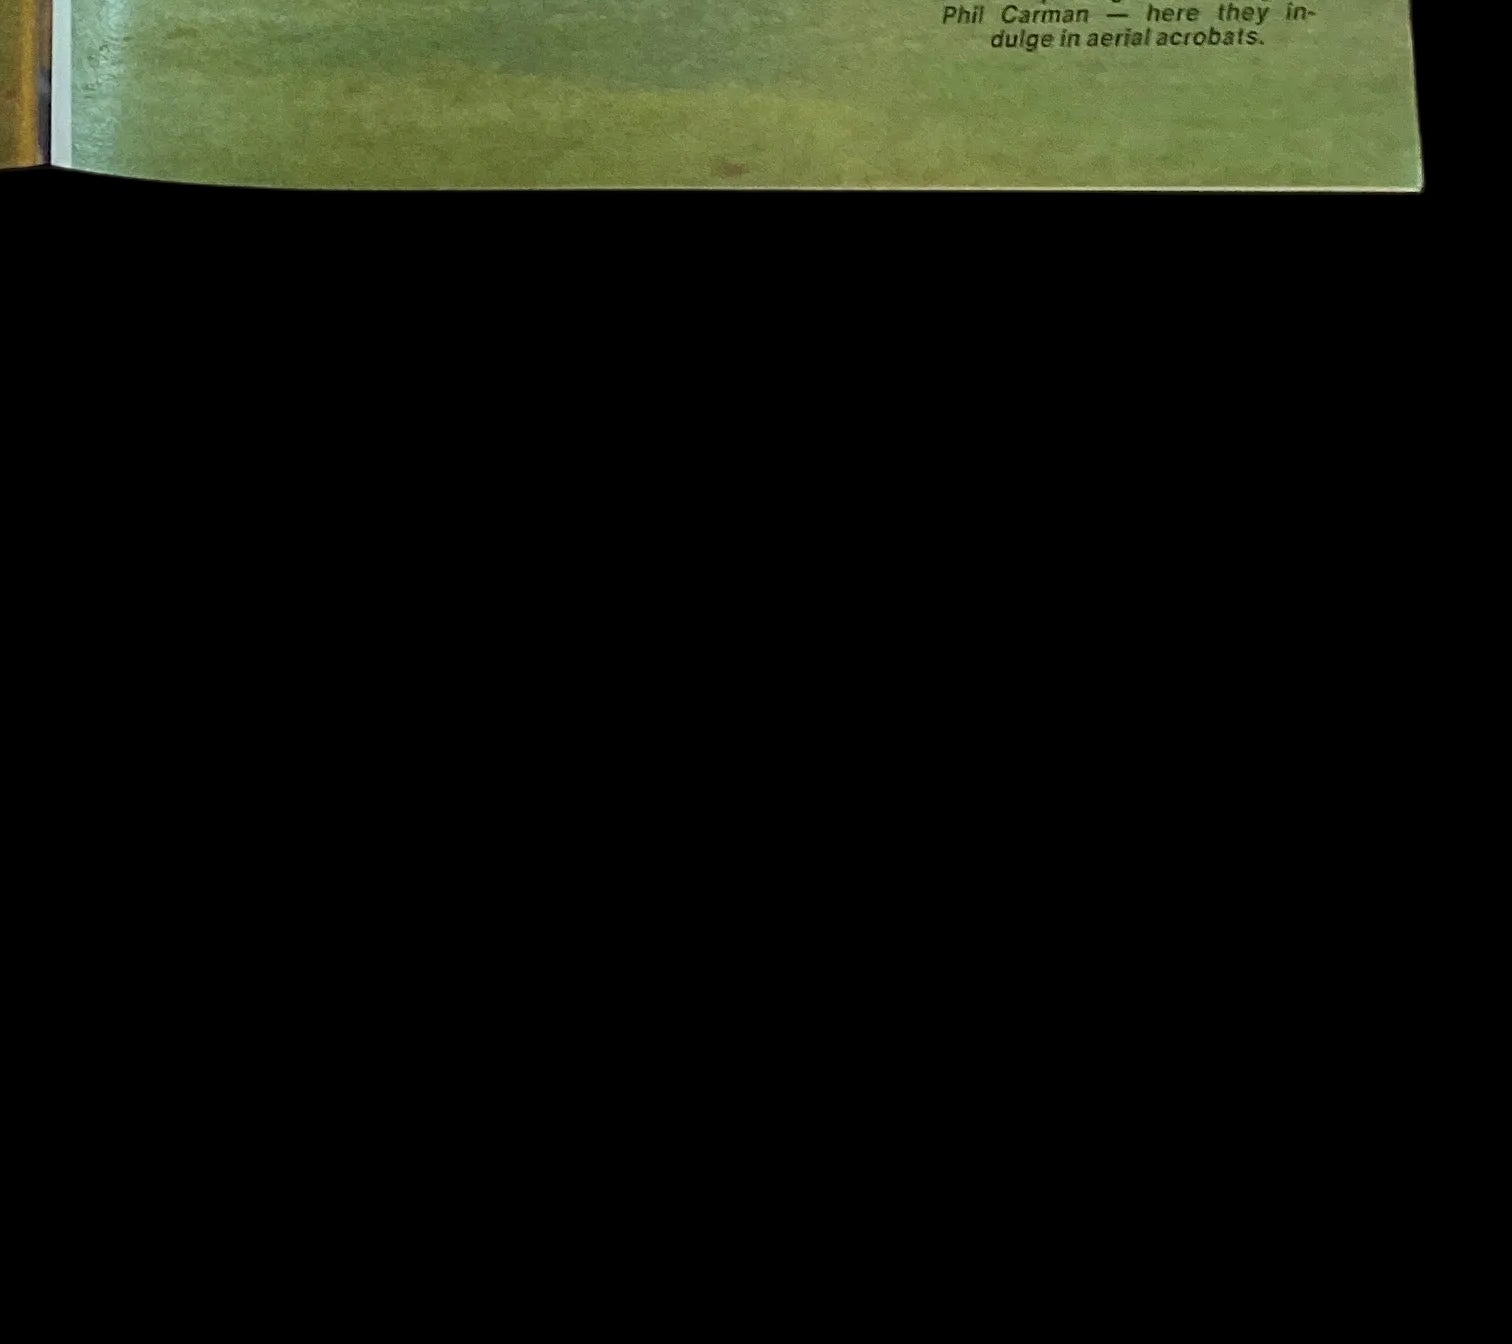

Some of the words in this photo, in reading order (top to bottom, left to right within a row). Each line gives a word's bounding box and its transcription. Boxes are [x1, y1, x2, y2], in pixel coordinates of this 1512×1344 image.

[942, 4, 985, 24] Phil
[1001, 4, 1089, 24] Carman
[1146, 4, 1200, 22] here
[1218, 2, 1269, 26] they
[1285, 2, 1316, 21] in-
[990, 29, 1054, 53] dulge
[1059, 28, 1080, 47] in
[1086, 27, 1151, 47] aerial
[1155, 26, 1265, 47] acrobats.
